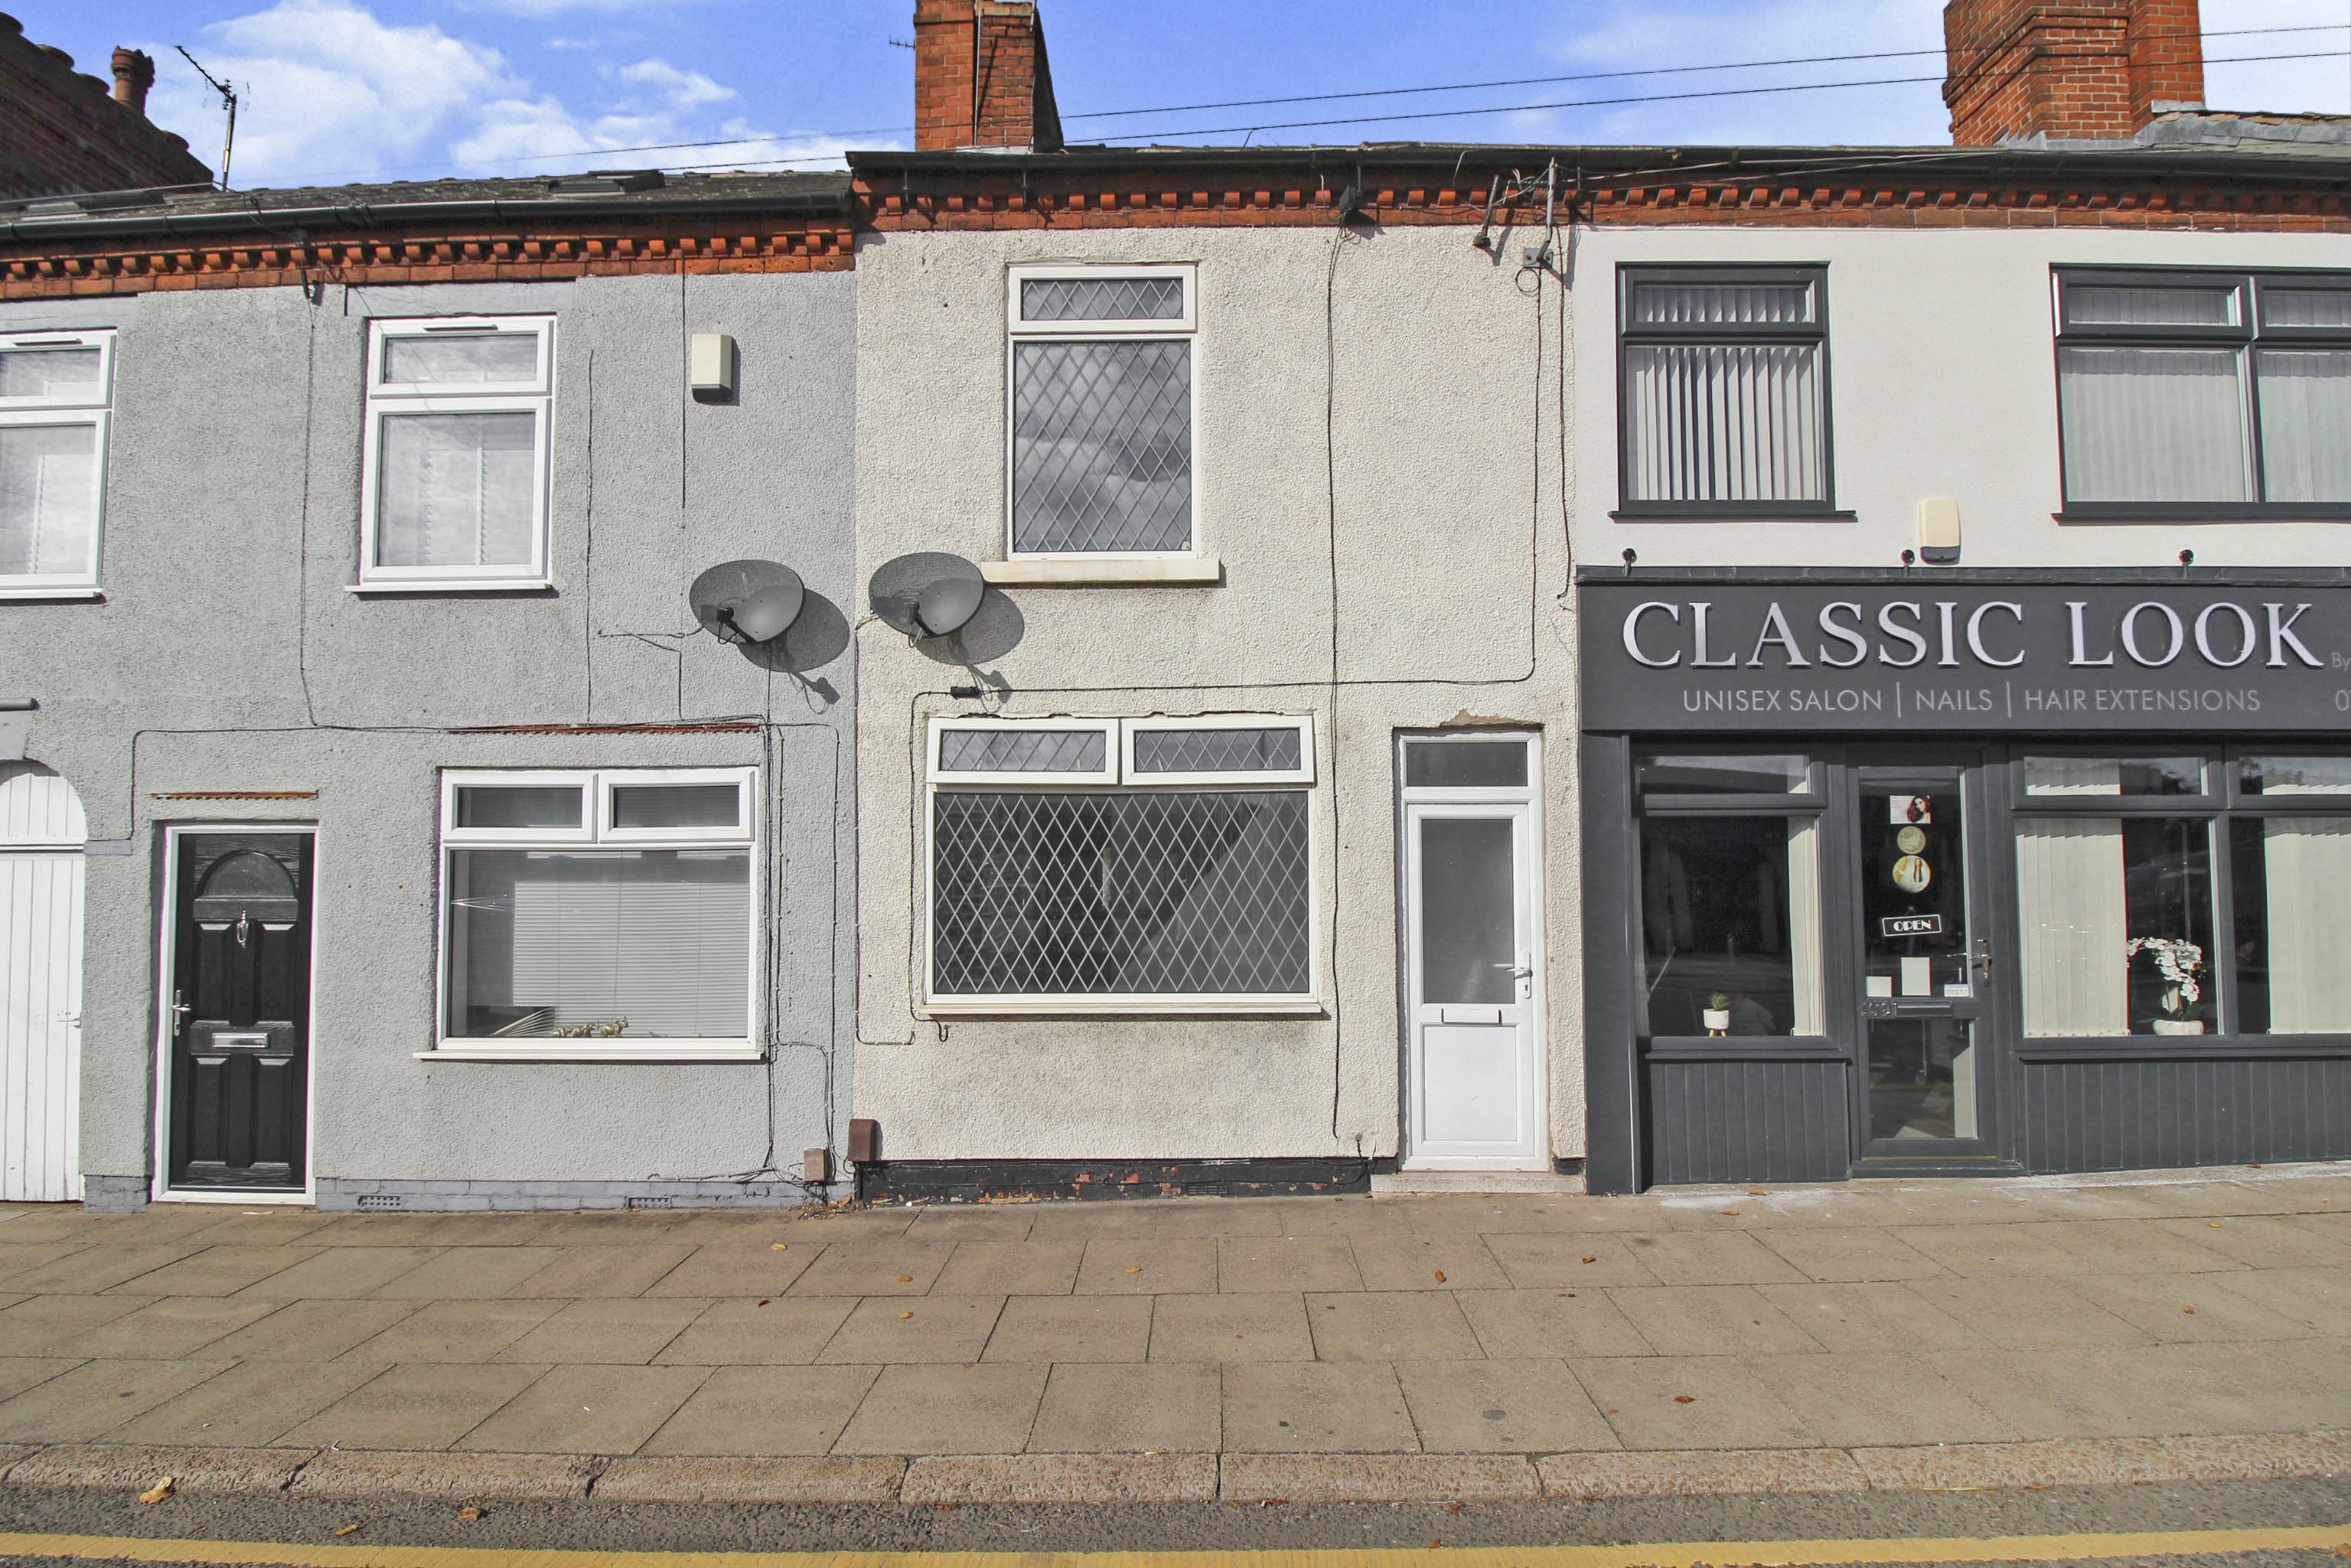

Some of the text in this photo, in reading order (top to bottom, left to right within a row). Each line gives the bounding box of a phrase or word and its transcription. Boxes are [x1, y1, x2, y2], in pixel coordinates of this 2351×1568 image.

[1622, 601, 2324, 667] CLASSIC LOOK
[1684, 690, 1881, 711] UNISEX SALON
[1916, 690, 1993, 711] NAILS
[2025, 690, 2260, 711] HAIR EXTENSIONS
[1893, 920, 1932, 931] OPEN
